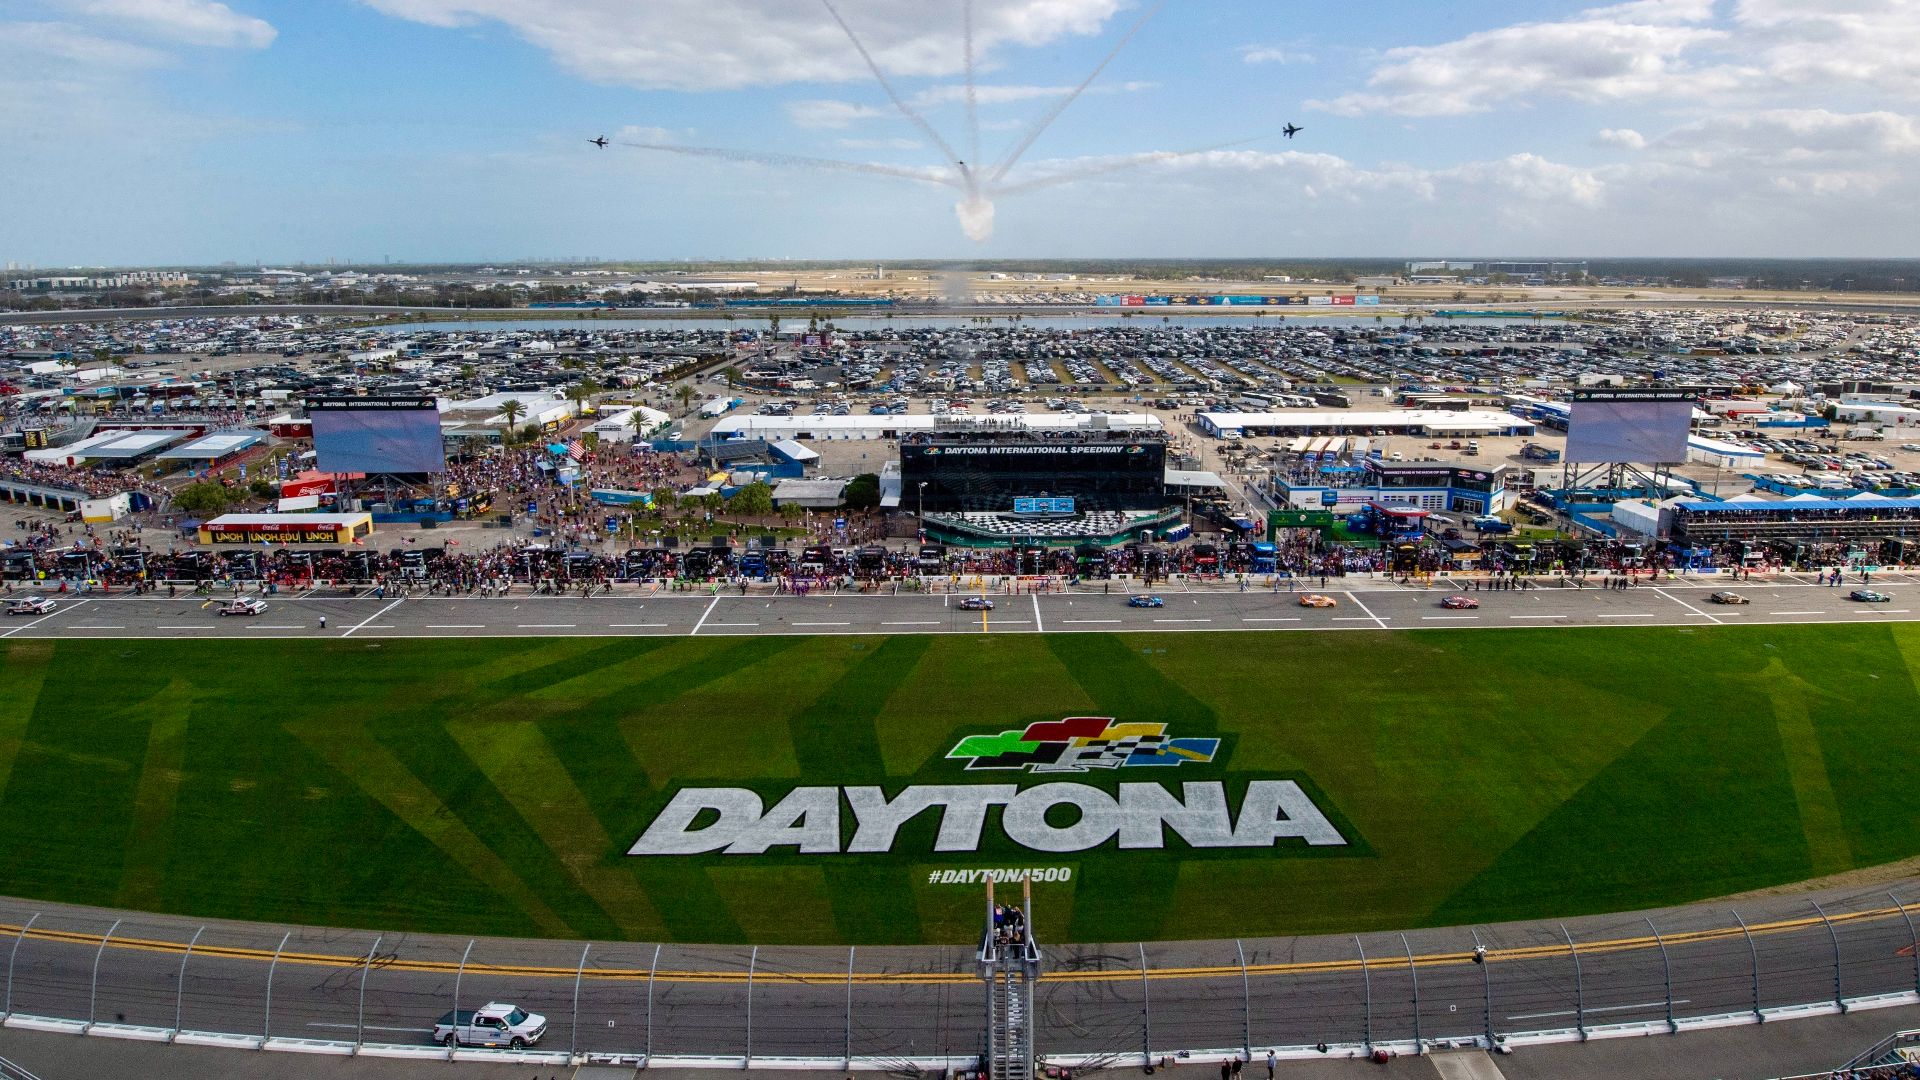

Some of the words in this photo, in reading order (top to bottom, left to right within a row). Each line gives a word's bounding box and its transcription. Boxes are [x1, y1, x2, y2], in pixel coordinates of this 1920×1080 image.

[216, 532, 244, 541] UNOH
[251, 532, 299, 542] UNOH.EDU
[306, 531, 333, 540] UNOH
[626, 779, 1349, 855] DAYTONA
[928, 867, 1072, 884] #DAYTONA500
